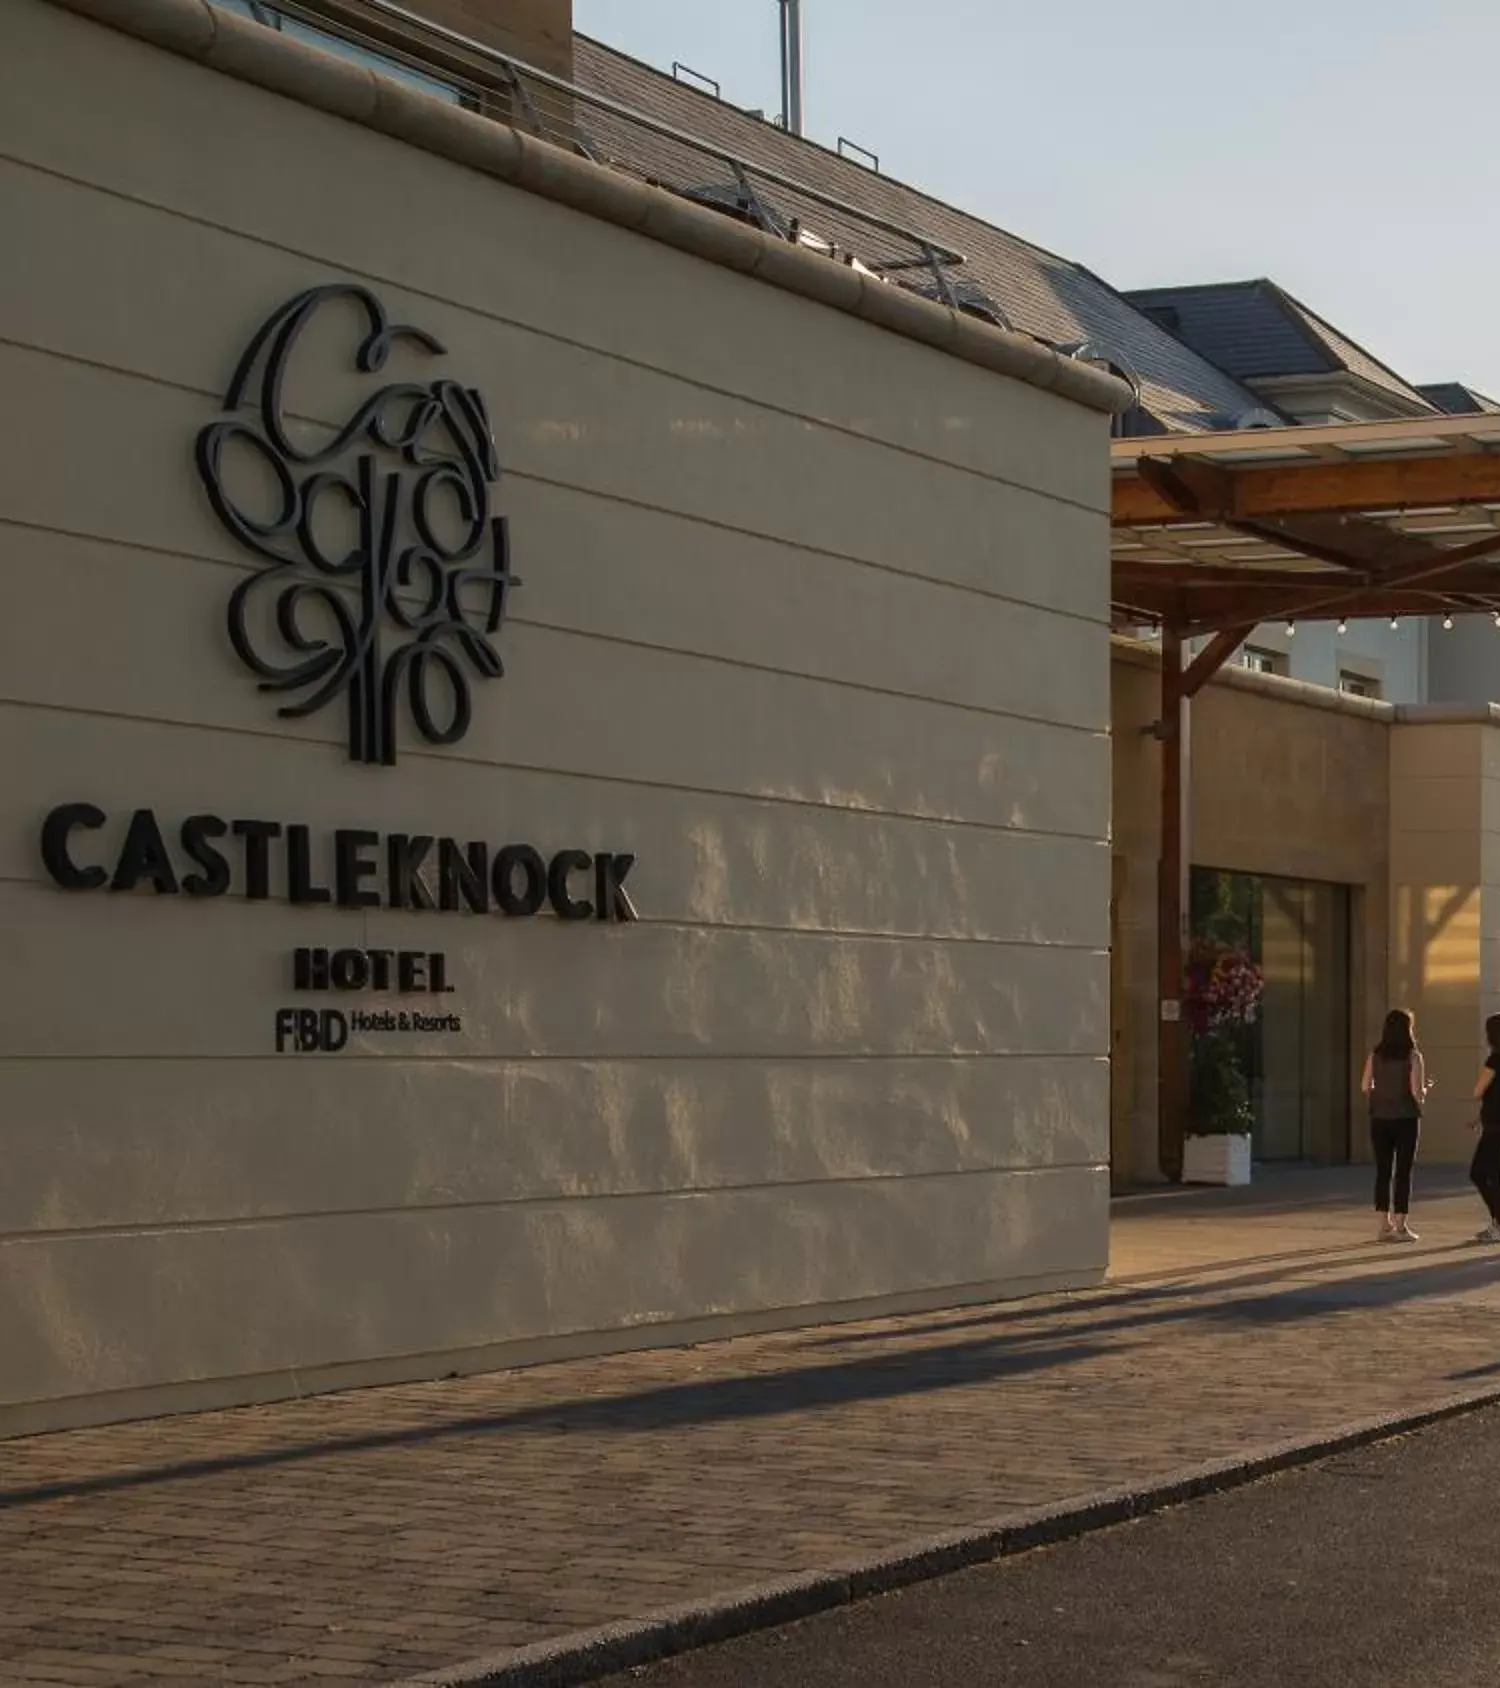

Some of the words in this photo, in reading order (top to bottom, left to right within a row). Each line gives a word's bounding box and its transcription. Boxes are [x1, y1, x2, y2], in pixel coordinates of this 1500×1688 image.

[40, 803, 638, 921] CASTLEKNOCK
[294, 947, 455, 993] HOTEL
[275, 1008, 348, 1053] FBD
[351, 1010, 396, 1032] Hotels
[398, 1012, 411, 1032] &
[411, 1012, 461, 1032] Resorts
